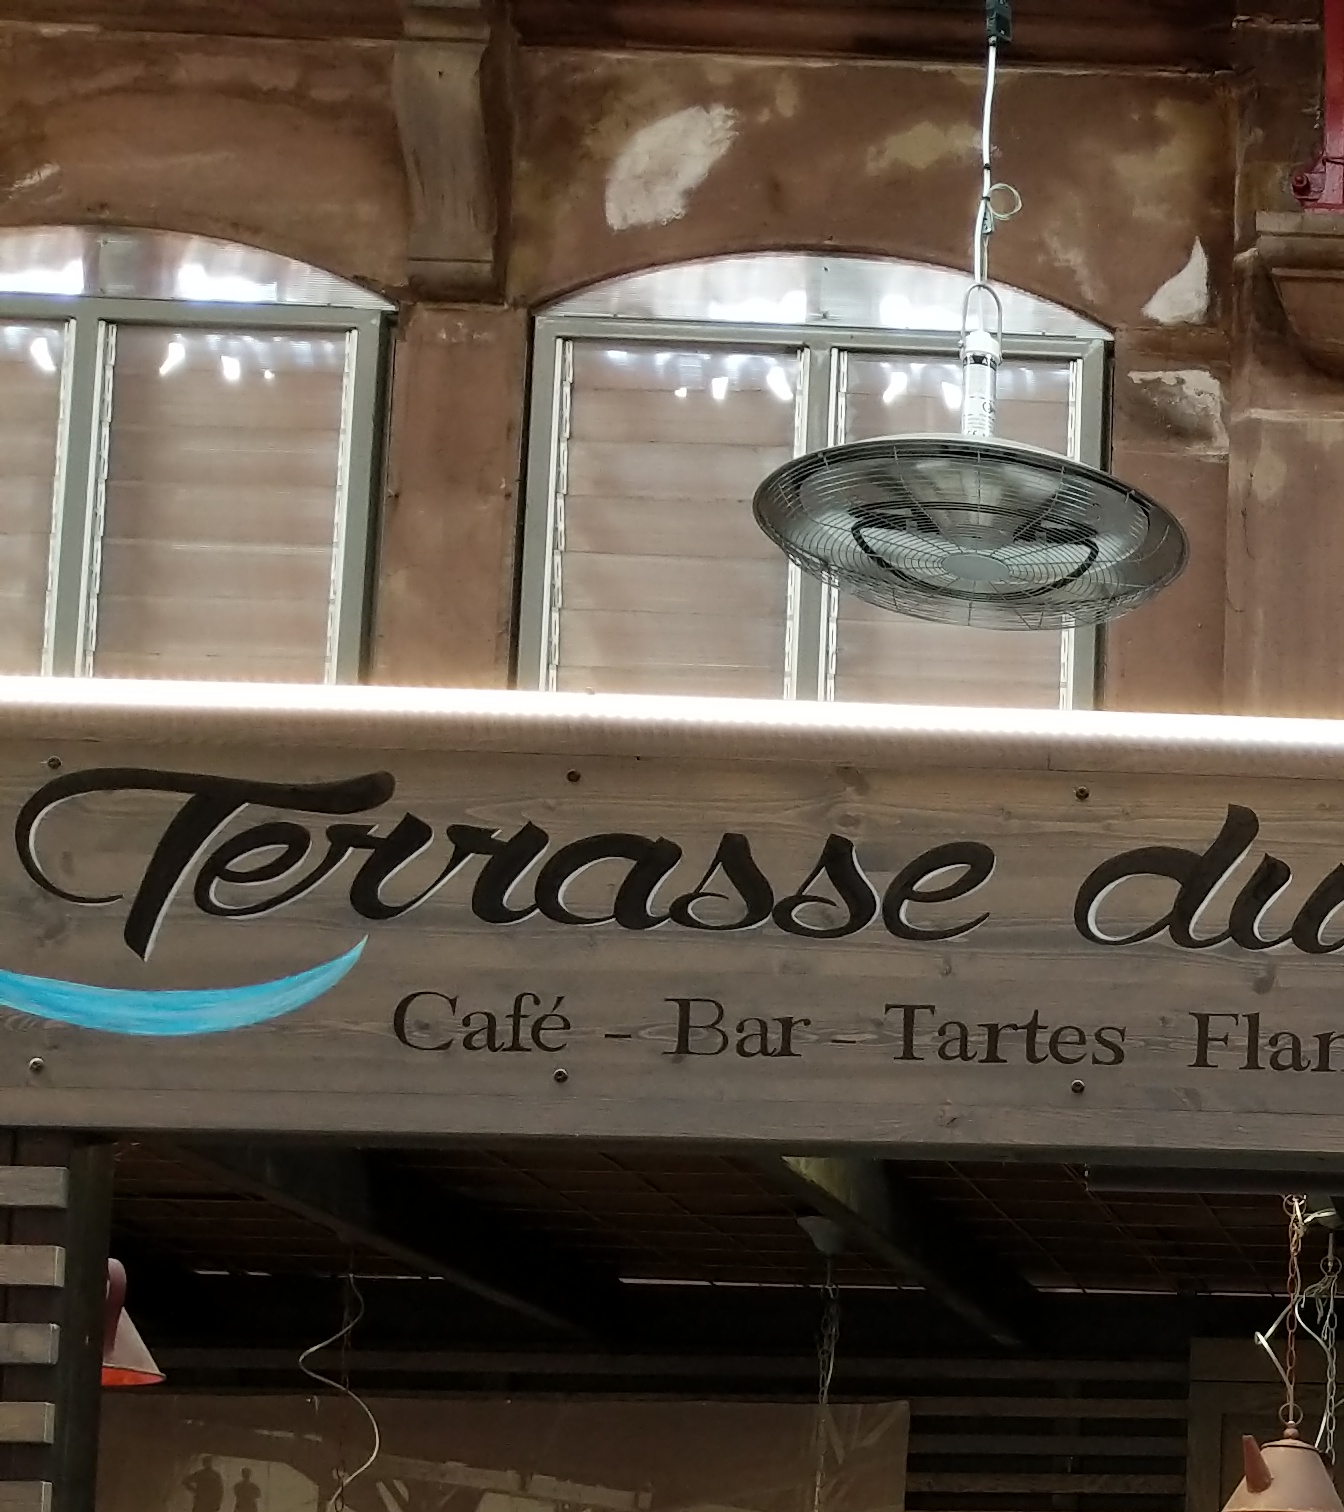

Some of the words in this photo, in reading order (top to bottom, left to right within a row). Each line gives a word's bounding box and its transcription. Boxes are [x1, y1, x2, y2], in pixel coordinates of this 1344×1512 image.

[15, 767, 997, 962] Terrasse
[393, 990, 571, 1054] Café
[662, 996, 812, 1058] Bar
[884, 1003, 1127, 1067] Tartes
